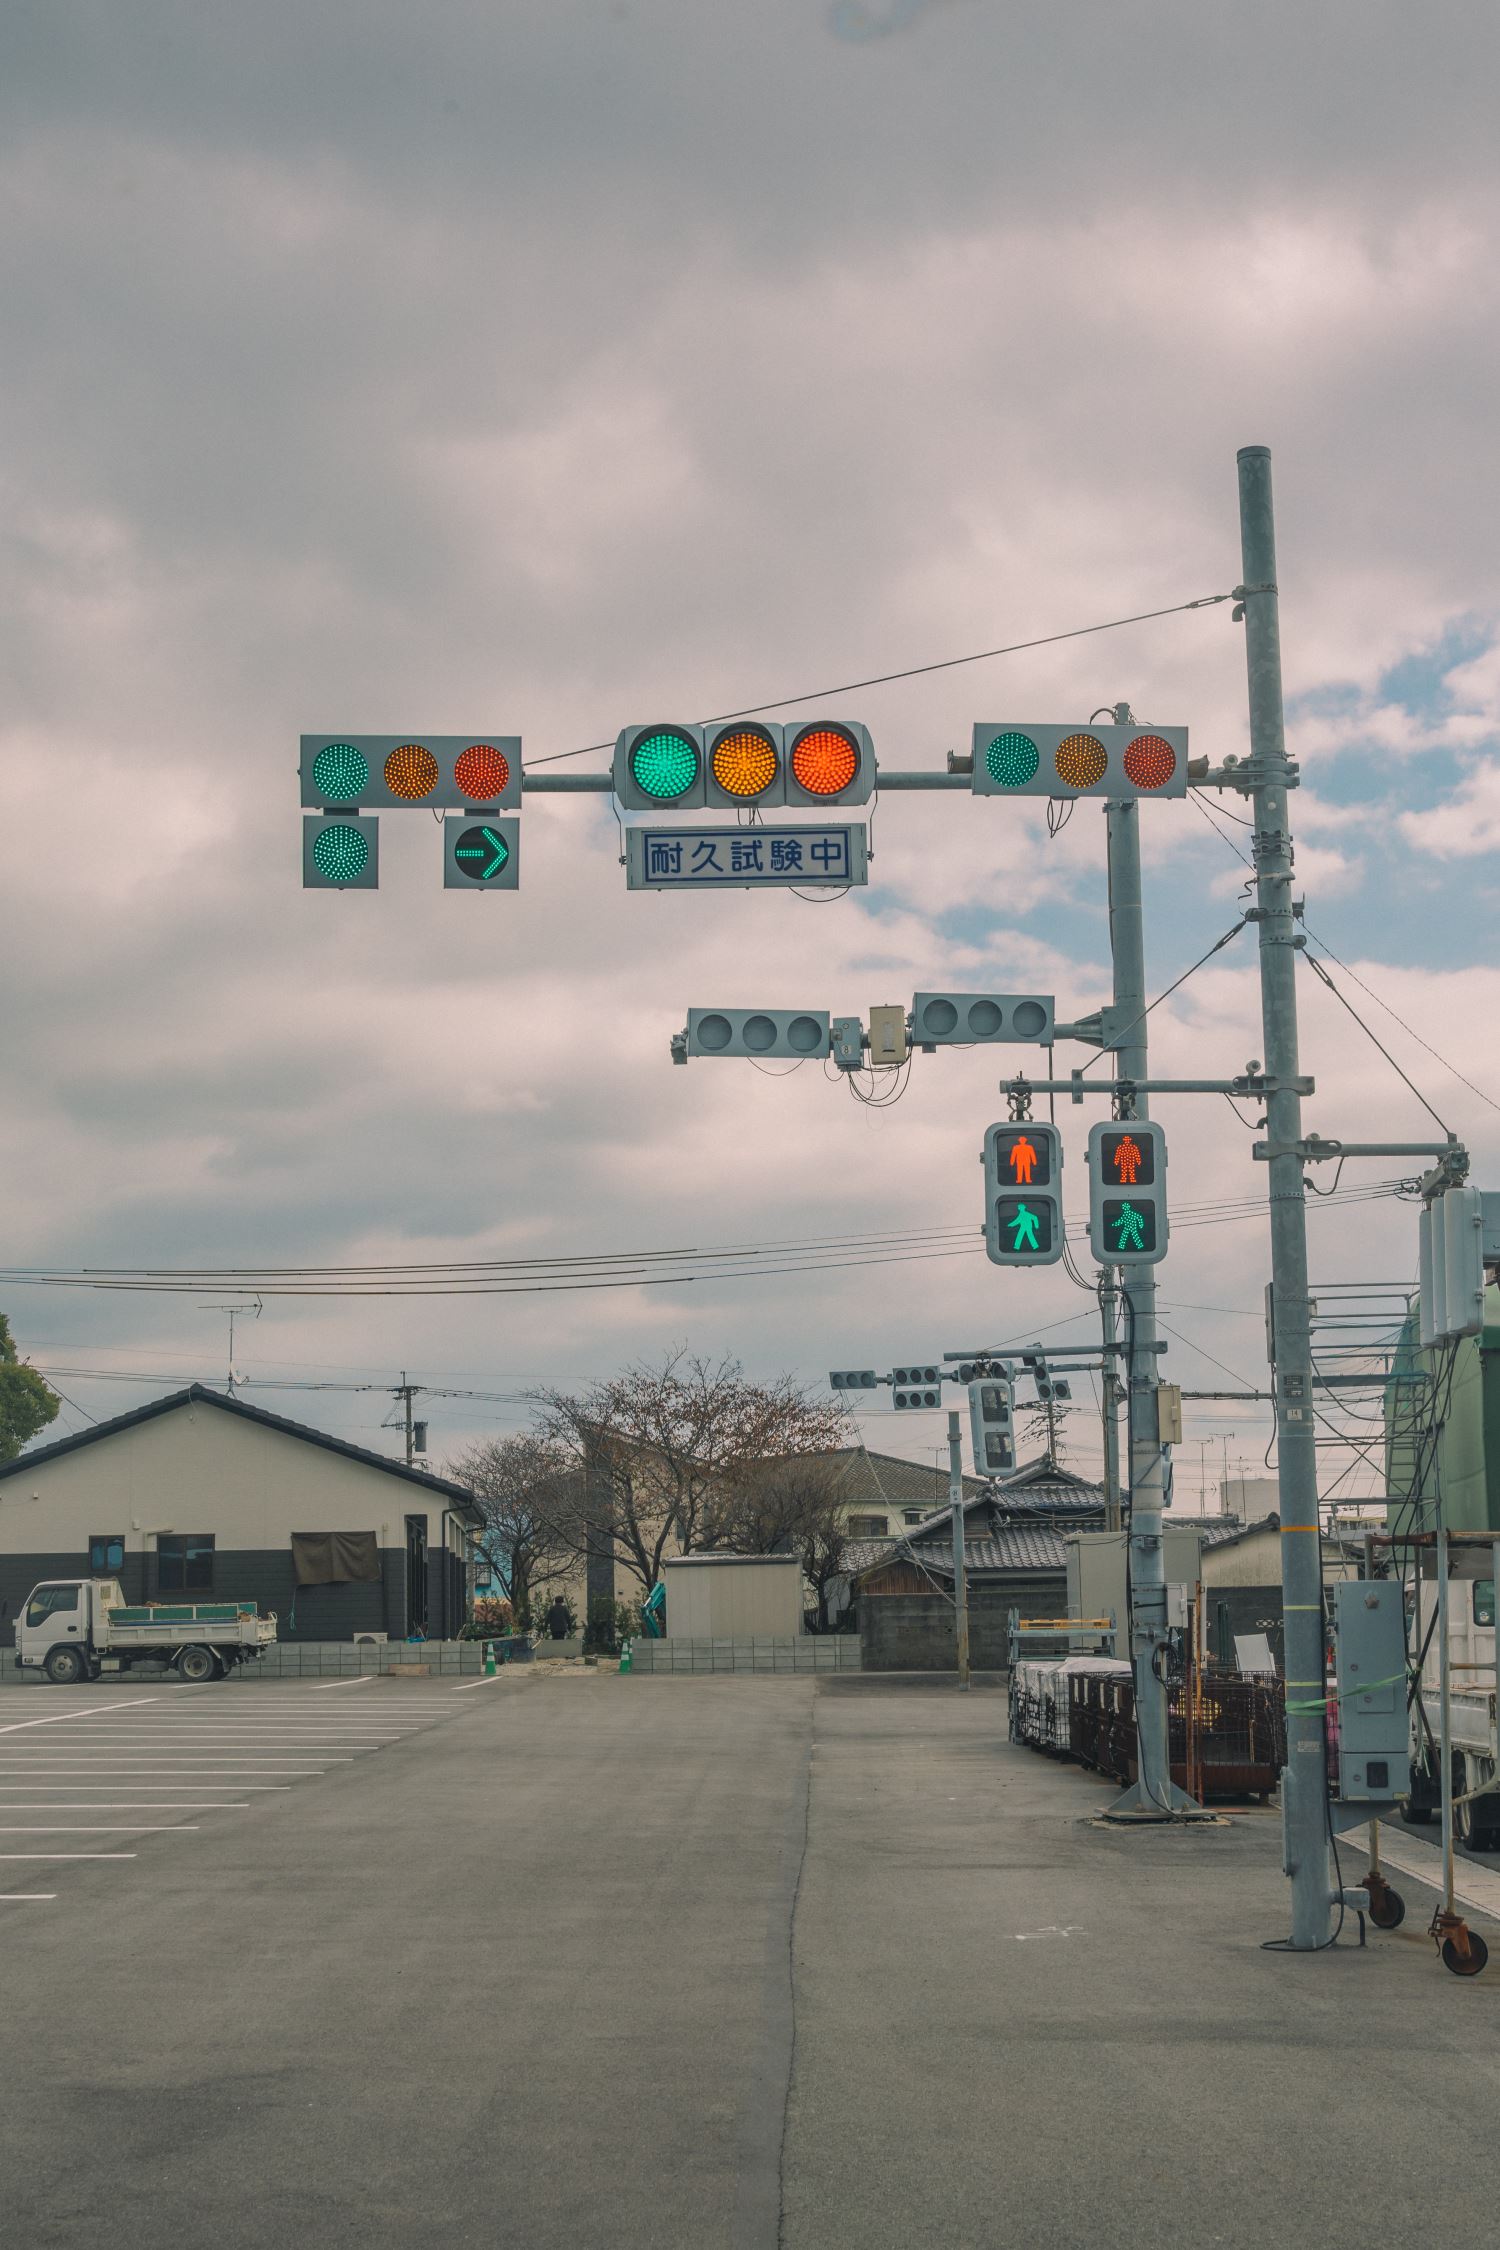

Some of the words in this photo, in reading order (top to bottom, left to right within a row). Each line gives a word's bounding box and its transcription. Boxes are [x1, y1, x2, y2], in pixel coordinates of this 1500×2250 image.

[651, 838, 841, 874] 耐久試験中
